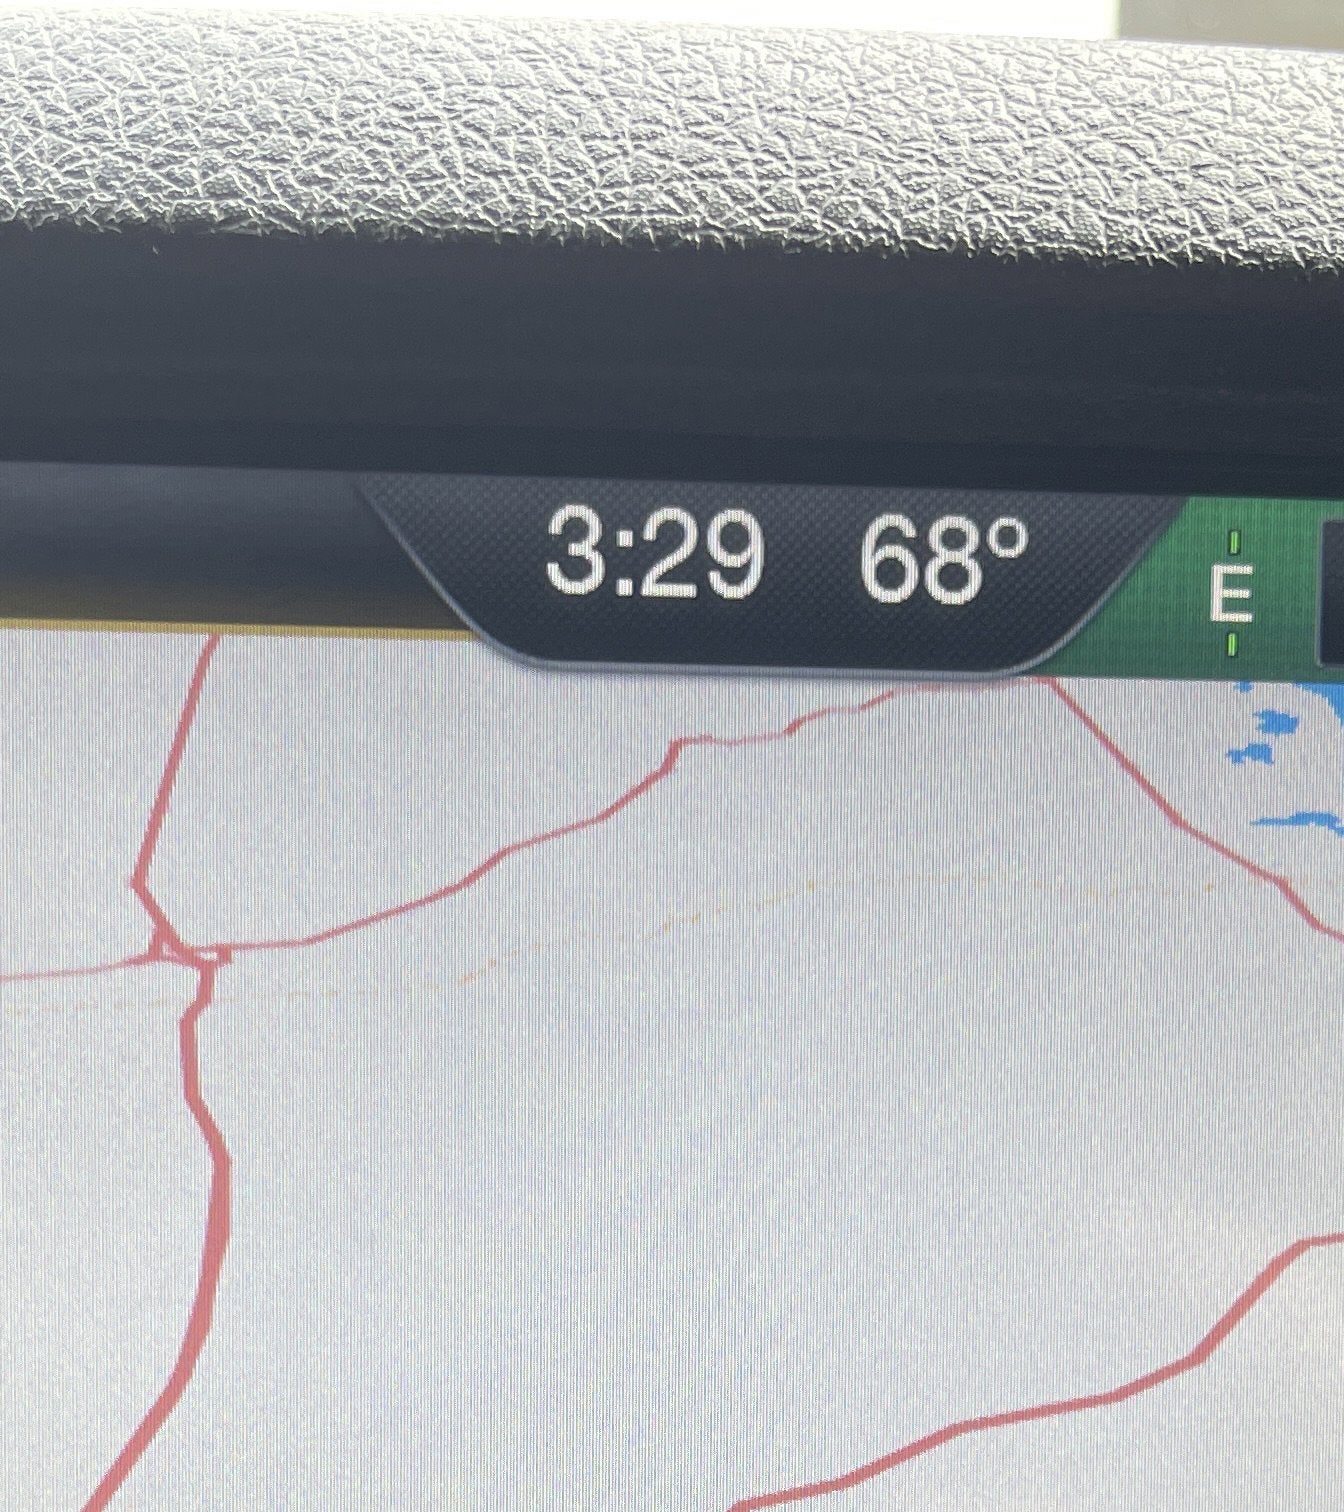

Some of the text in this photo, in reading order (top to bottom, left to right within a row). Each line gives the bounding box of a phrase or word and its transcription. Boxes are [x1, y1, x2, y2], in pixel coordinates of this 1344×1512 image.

[546, 504, 765, 599] 3:29
[860, 513, 1029, 604] 68°
[1210, 564, 1254, 623] E
